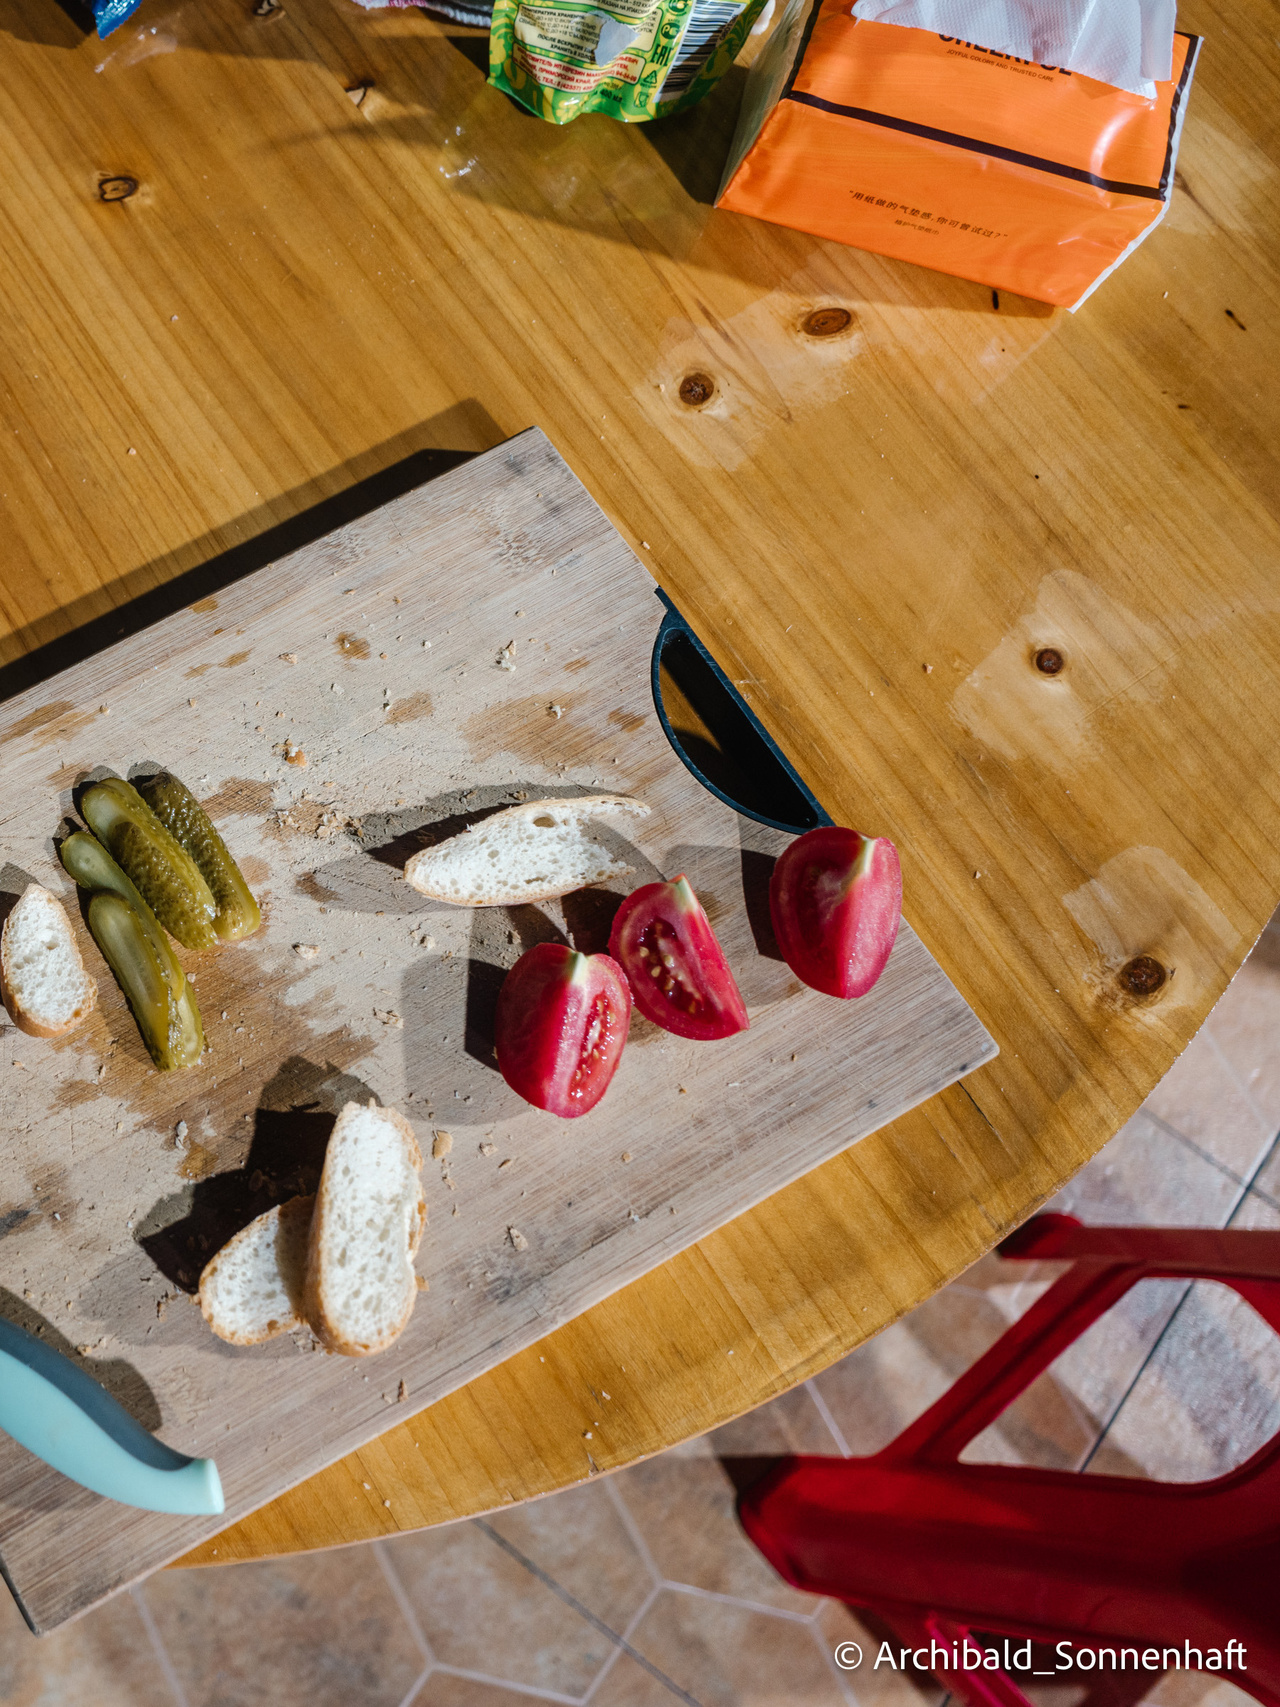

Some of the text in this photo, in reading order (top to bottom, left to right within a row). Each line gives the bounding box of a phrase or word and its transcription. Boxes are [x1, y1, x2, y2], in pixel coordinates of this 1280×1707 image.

[946, 48, 1054, 83] JOYFUL COLORS AND TRUSTED CARE
